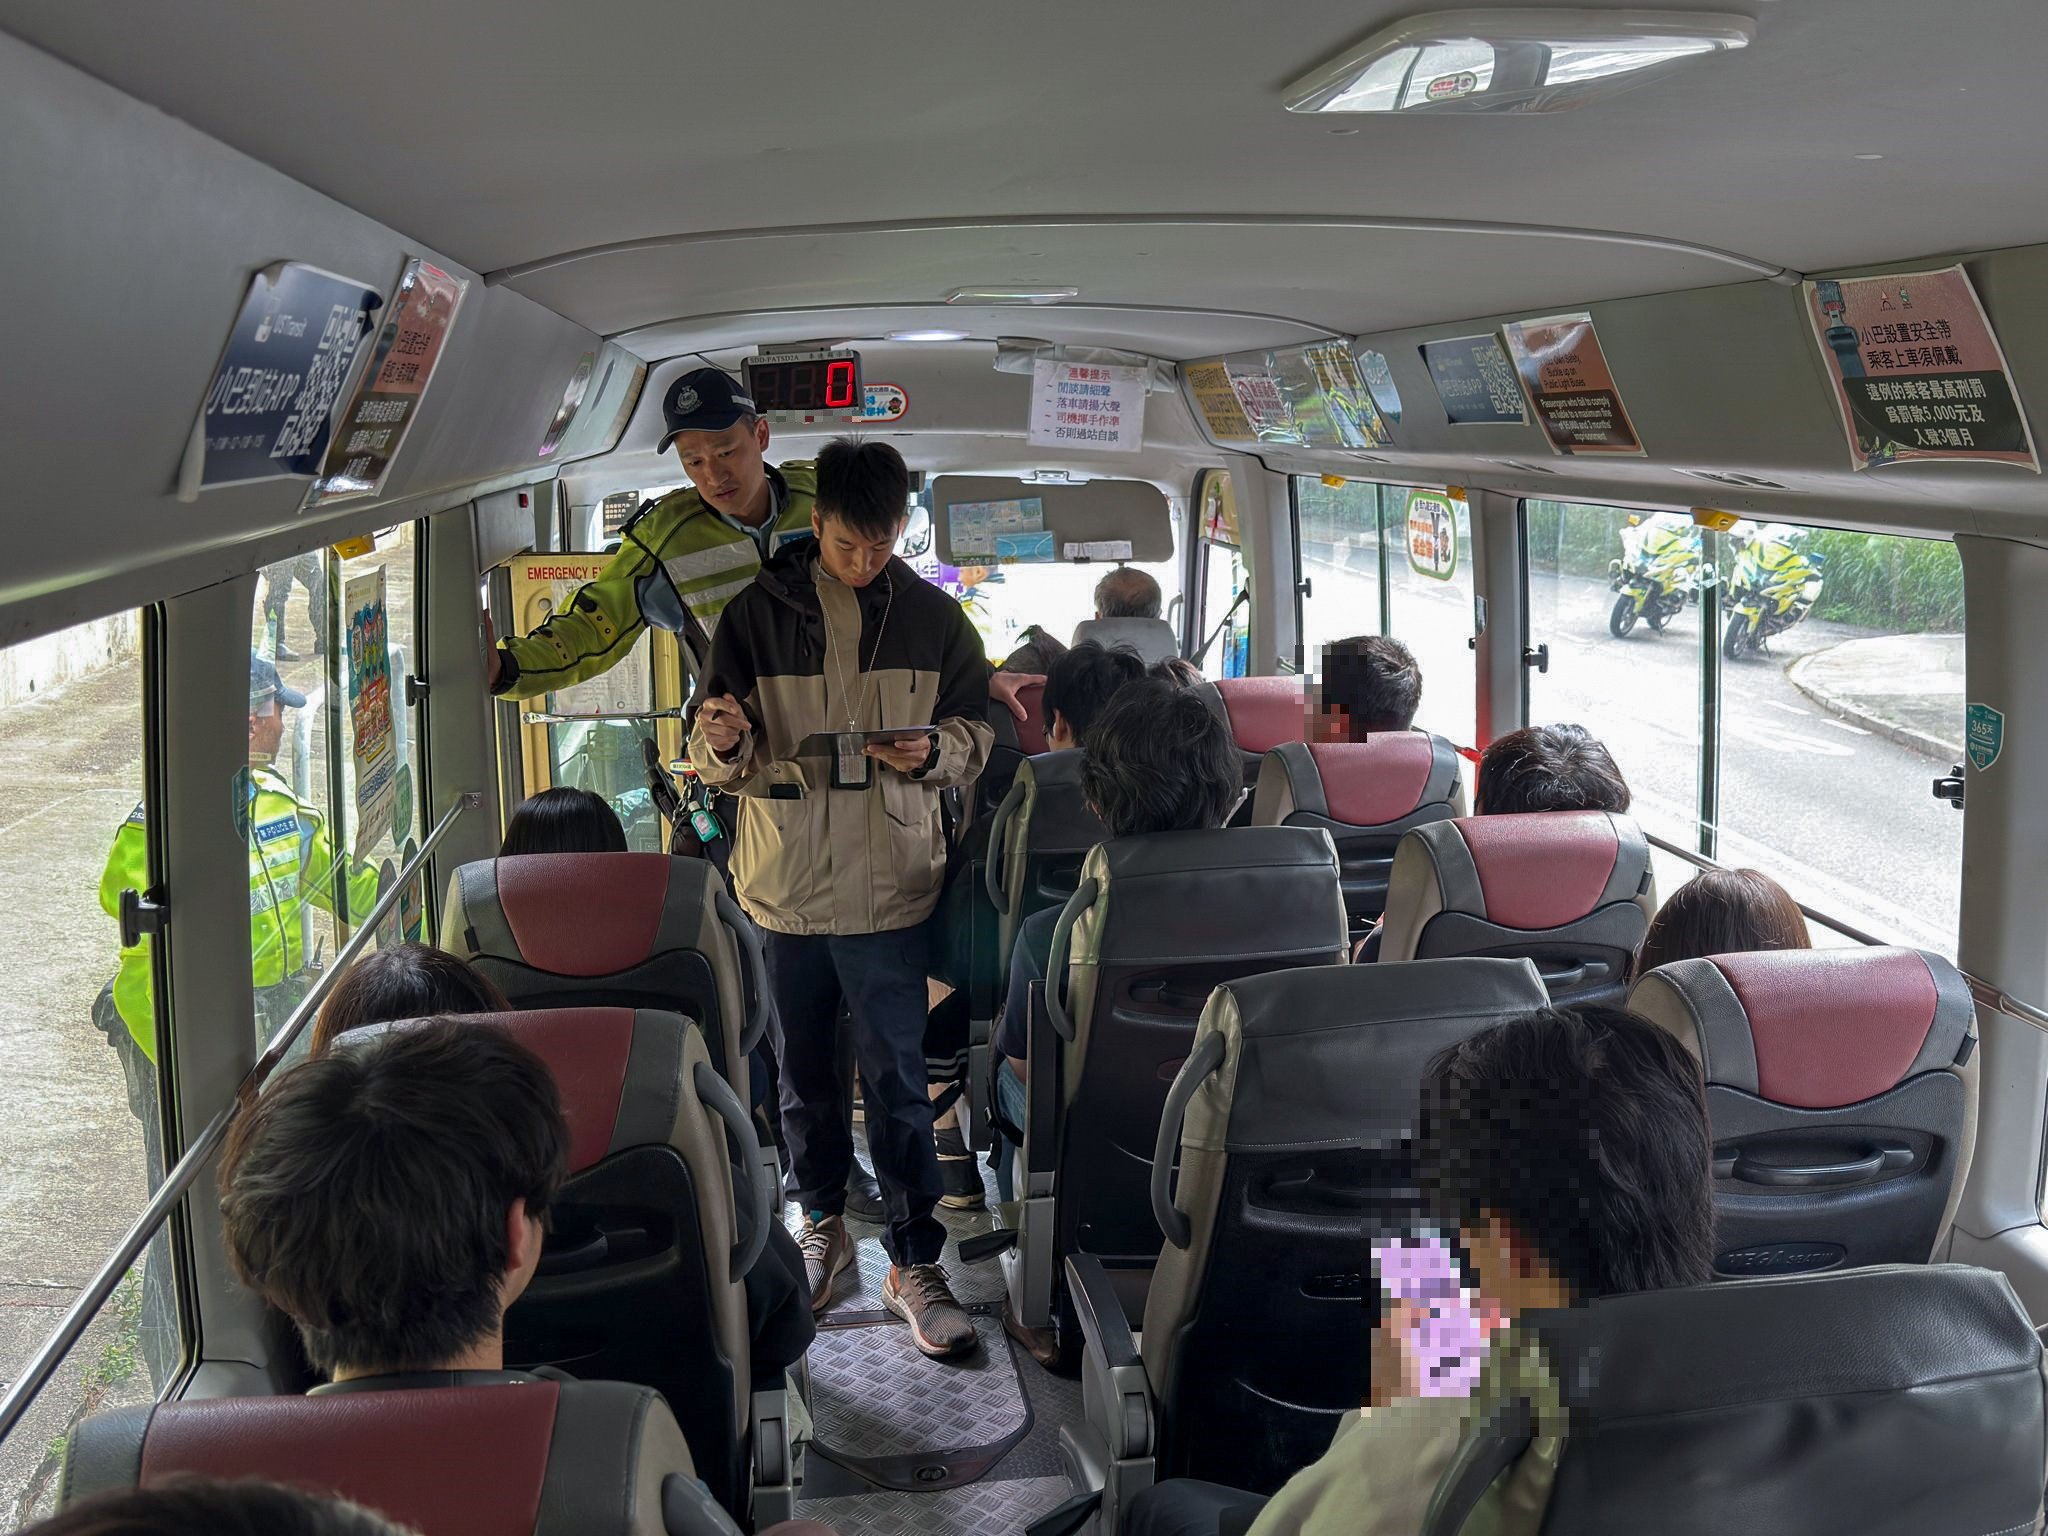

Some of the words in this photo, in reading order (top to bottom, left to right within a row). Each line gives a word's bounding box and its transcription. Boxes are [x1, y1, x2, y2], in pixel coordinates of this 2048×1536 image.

[1861, 319, 1952, 345] 小巴設置安全帶
[1867, 345, 1962, 369] 乘客上車須佩戴
[825, 361, 854, 407] 0
[1865, 378, 1987, 401] 違例的乘客最高刑罰
[1914, 428, 1975, 447] 入獄3個月
[527, 566, 588, 580] EMERGENCY
[1971, 719, 1993, 735] 365天
